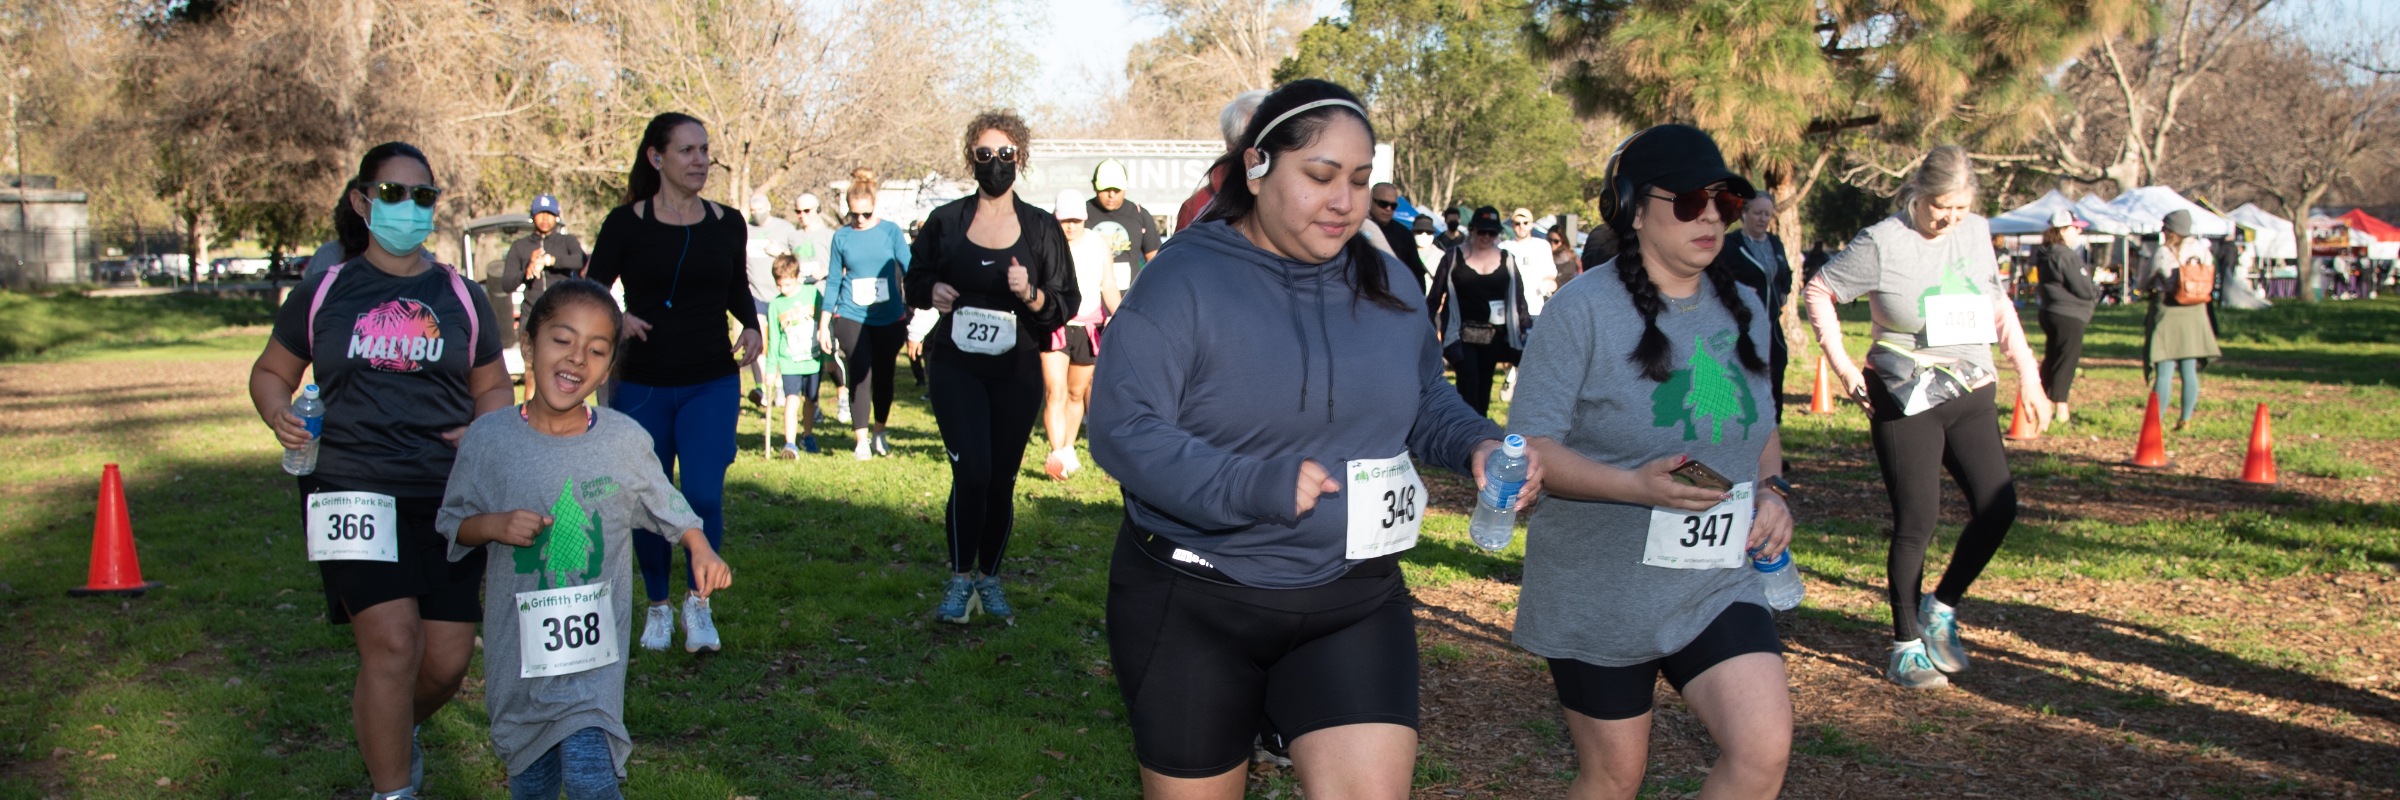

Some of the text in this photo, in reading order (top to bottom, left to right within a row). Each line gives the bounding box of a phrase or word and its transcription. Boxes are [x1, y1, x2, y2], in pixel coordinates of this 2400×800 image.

[1945, 311, 1976, 329] 448
[967, 322, 1000, 343] 237
[347, 334, 445, 362] MALIBU
[321, 497, 393, 508] Griffith Park Run
[583, 488, 605, 499] Park
[1736, 490, 1748, 500] Run
[1381, 485, 1416, 529] 348
[327, 513, 375, 541] 366
[1680, 513, 1734, 548] 347
[531, 597, 571, 608] Griffith
[575, 591, 599, 604] Park
[542, 612, 600, 651] 368
